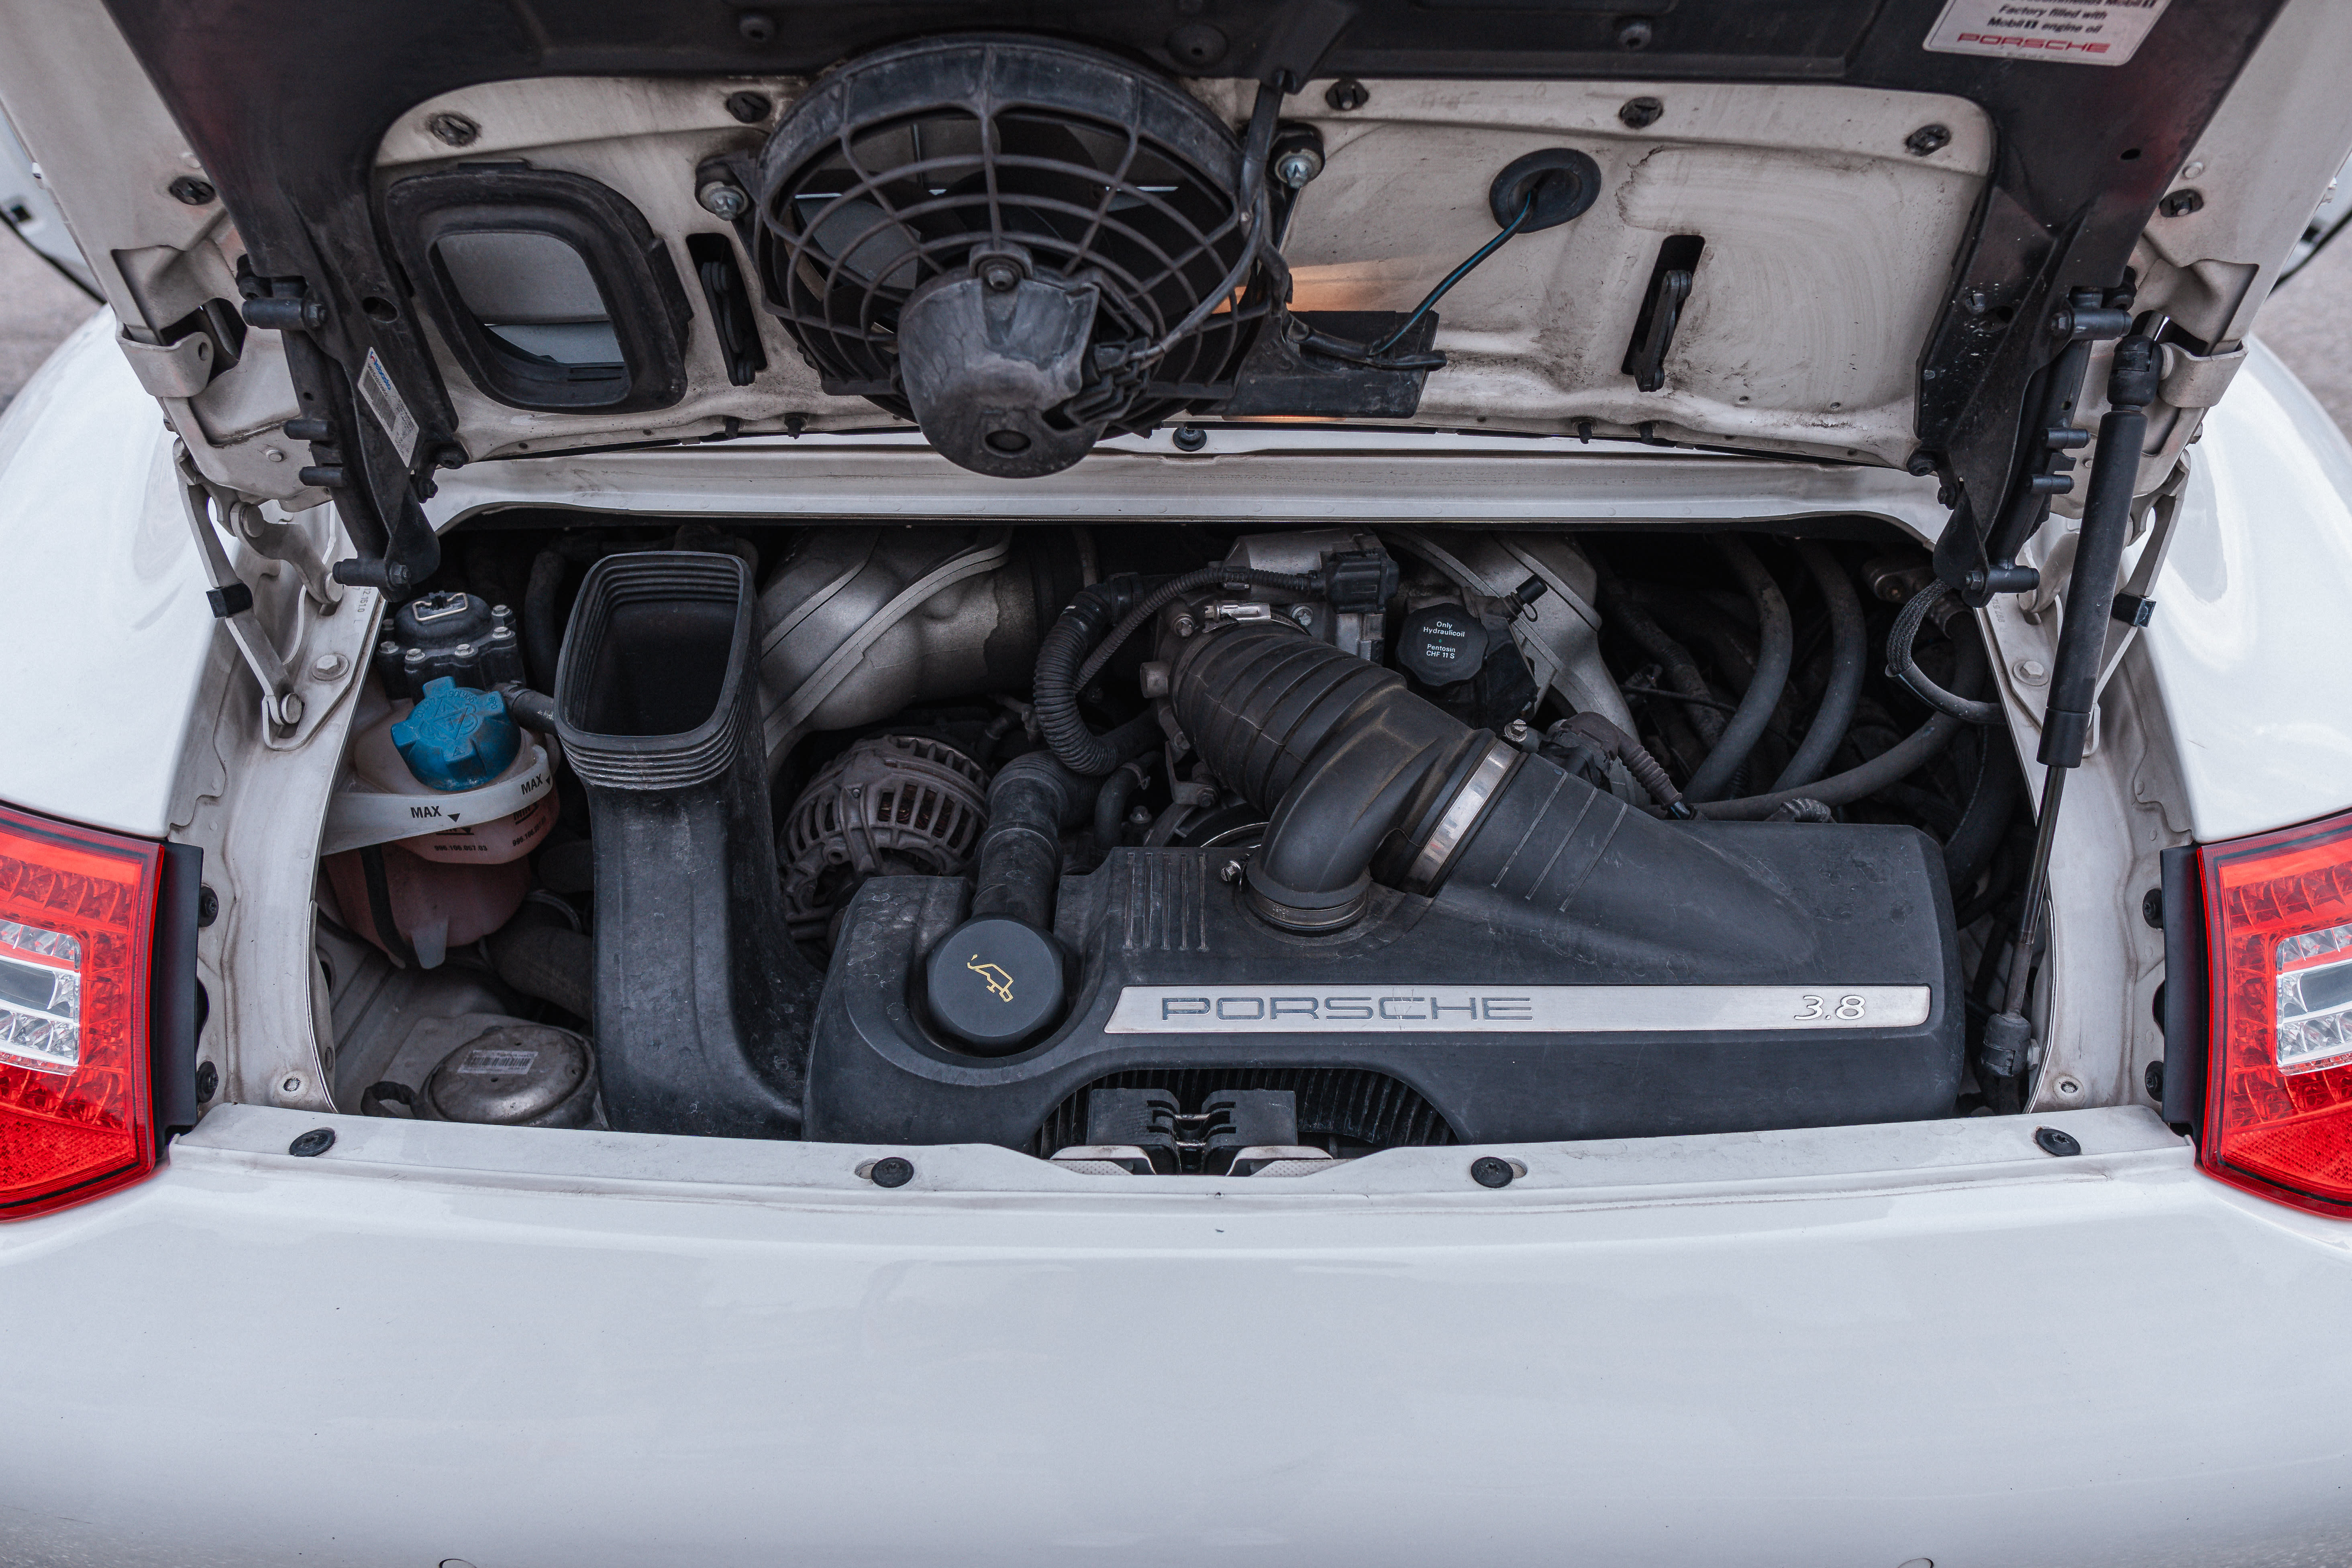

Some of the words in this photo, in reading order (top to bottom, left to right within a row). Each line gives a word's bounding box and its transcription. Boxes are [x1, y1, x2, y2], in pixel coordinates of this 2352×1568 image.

[1999, 4, 2047, 18] Factory
[2048, 8, 2081, 18] filled
[2082, 10, 2107, 20] with
[2041, 23, 2083, 33] engine
[2085, 24, 2103, 33] oil
[1957, 33, 2111, 53] PORSCHE
[1423, 626, 1465, 637] Hydraulicoil
[1437, 621, 1452, 629] Only
[1427, 644, 1455, 652] Pentosin
[521, 773, 543, 795] MAX
[410, 805, 442, 818] MAX
[1161, 996, 1534, 1021] PORSCHE
[1793, 995, 1866, 1020] 3.8
